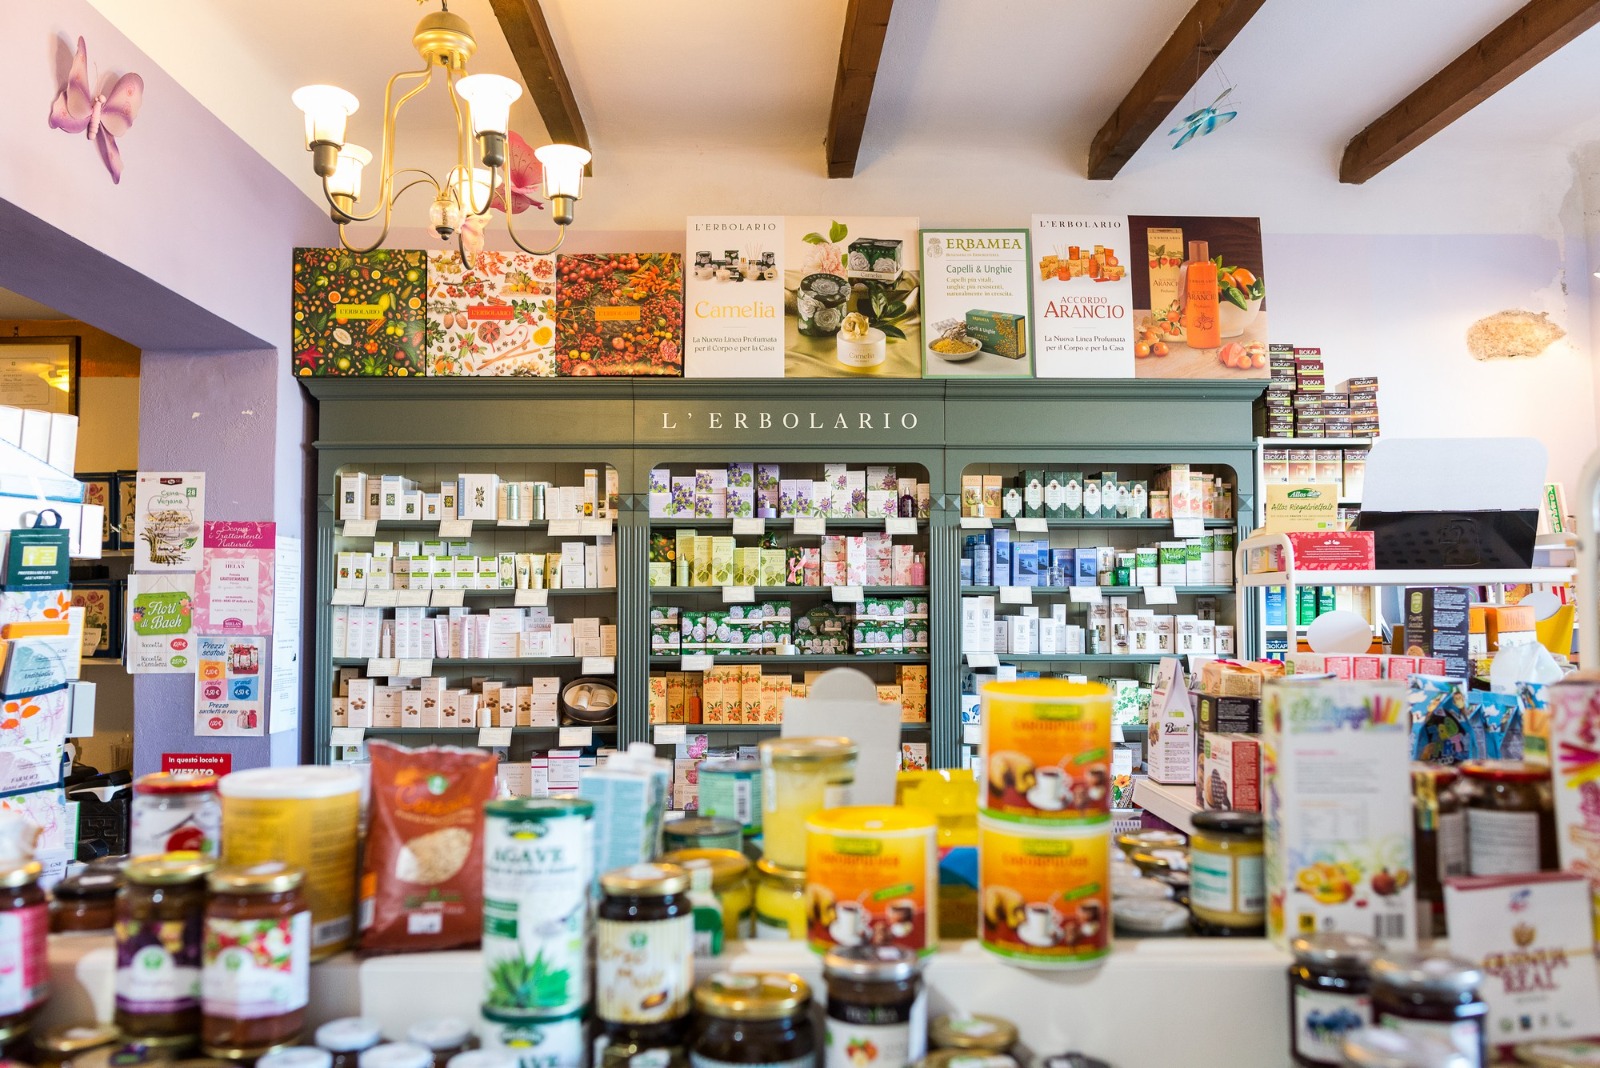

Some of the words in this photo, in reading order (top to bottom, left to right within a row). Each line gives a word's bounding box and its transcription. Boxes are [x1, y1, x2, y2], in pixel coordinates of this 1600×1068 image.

[696, 223, 776, 231] L'ERBOLARIO
[1040, 220, 1121, 228] L'ERBOLARIO
[946, 239, 1022, 251] ERBAMEA
[946, 265, 973, 275] Capelli
[984, 265, 1012, 275] Unghie
[1061, 296, 1108, 304] ACCORDO
[695, 300, 775, 318] Camelia
[1044, 301, 1124, 319] ARANCIO
[157, 498, 183, 506] Vegana
[222, 522, 250, 534] Scopri
[216, 531, 263, 539] Trattamenti
[218, 539, 254, 547] Naturali
[148, 601, 176, 616] Fiori
[141, 619, 148, 627] di
[151, 615, 182, 629] Bach
